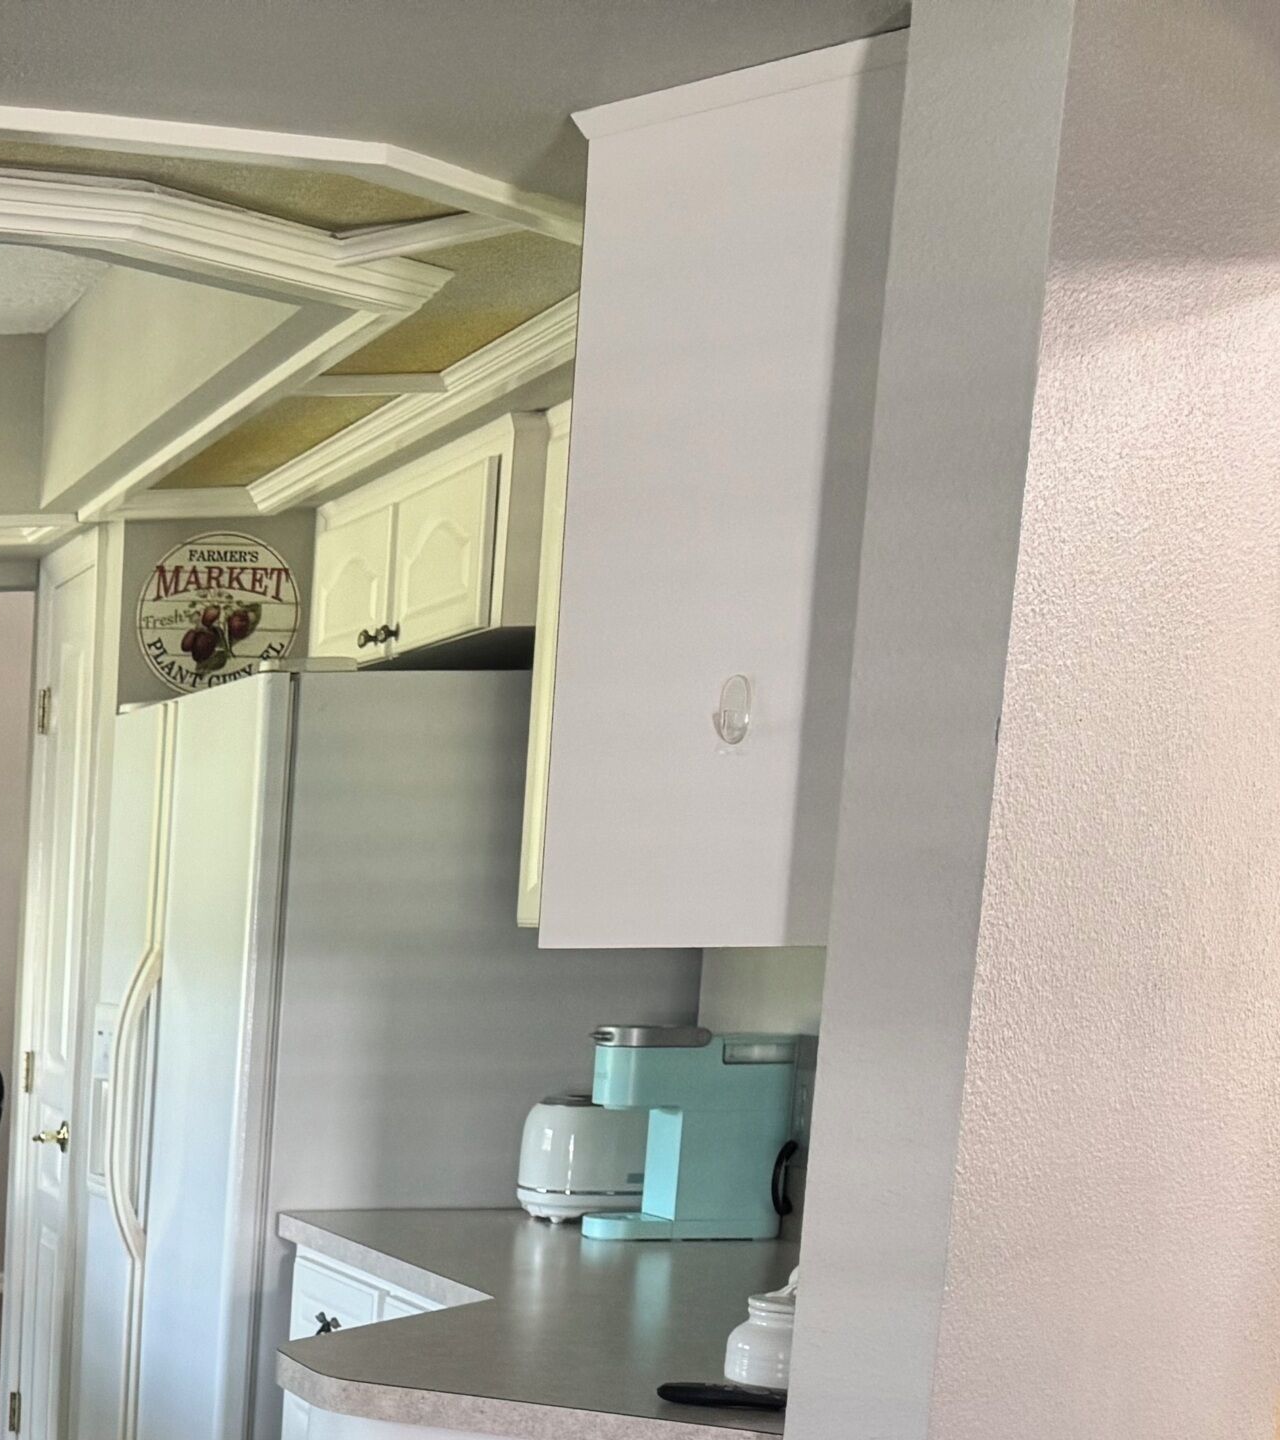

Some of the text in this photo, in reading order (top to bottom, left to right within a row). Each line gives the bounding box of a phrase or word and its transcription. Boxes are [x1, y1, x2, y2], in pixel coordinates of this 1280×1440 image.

[188, 549, 260, 563] FARMER'S
[152, 565, 289, 602] MARKET
[147, 637, 203, 688] PLANT
